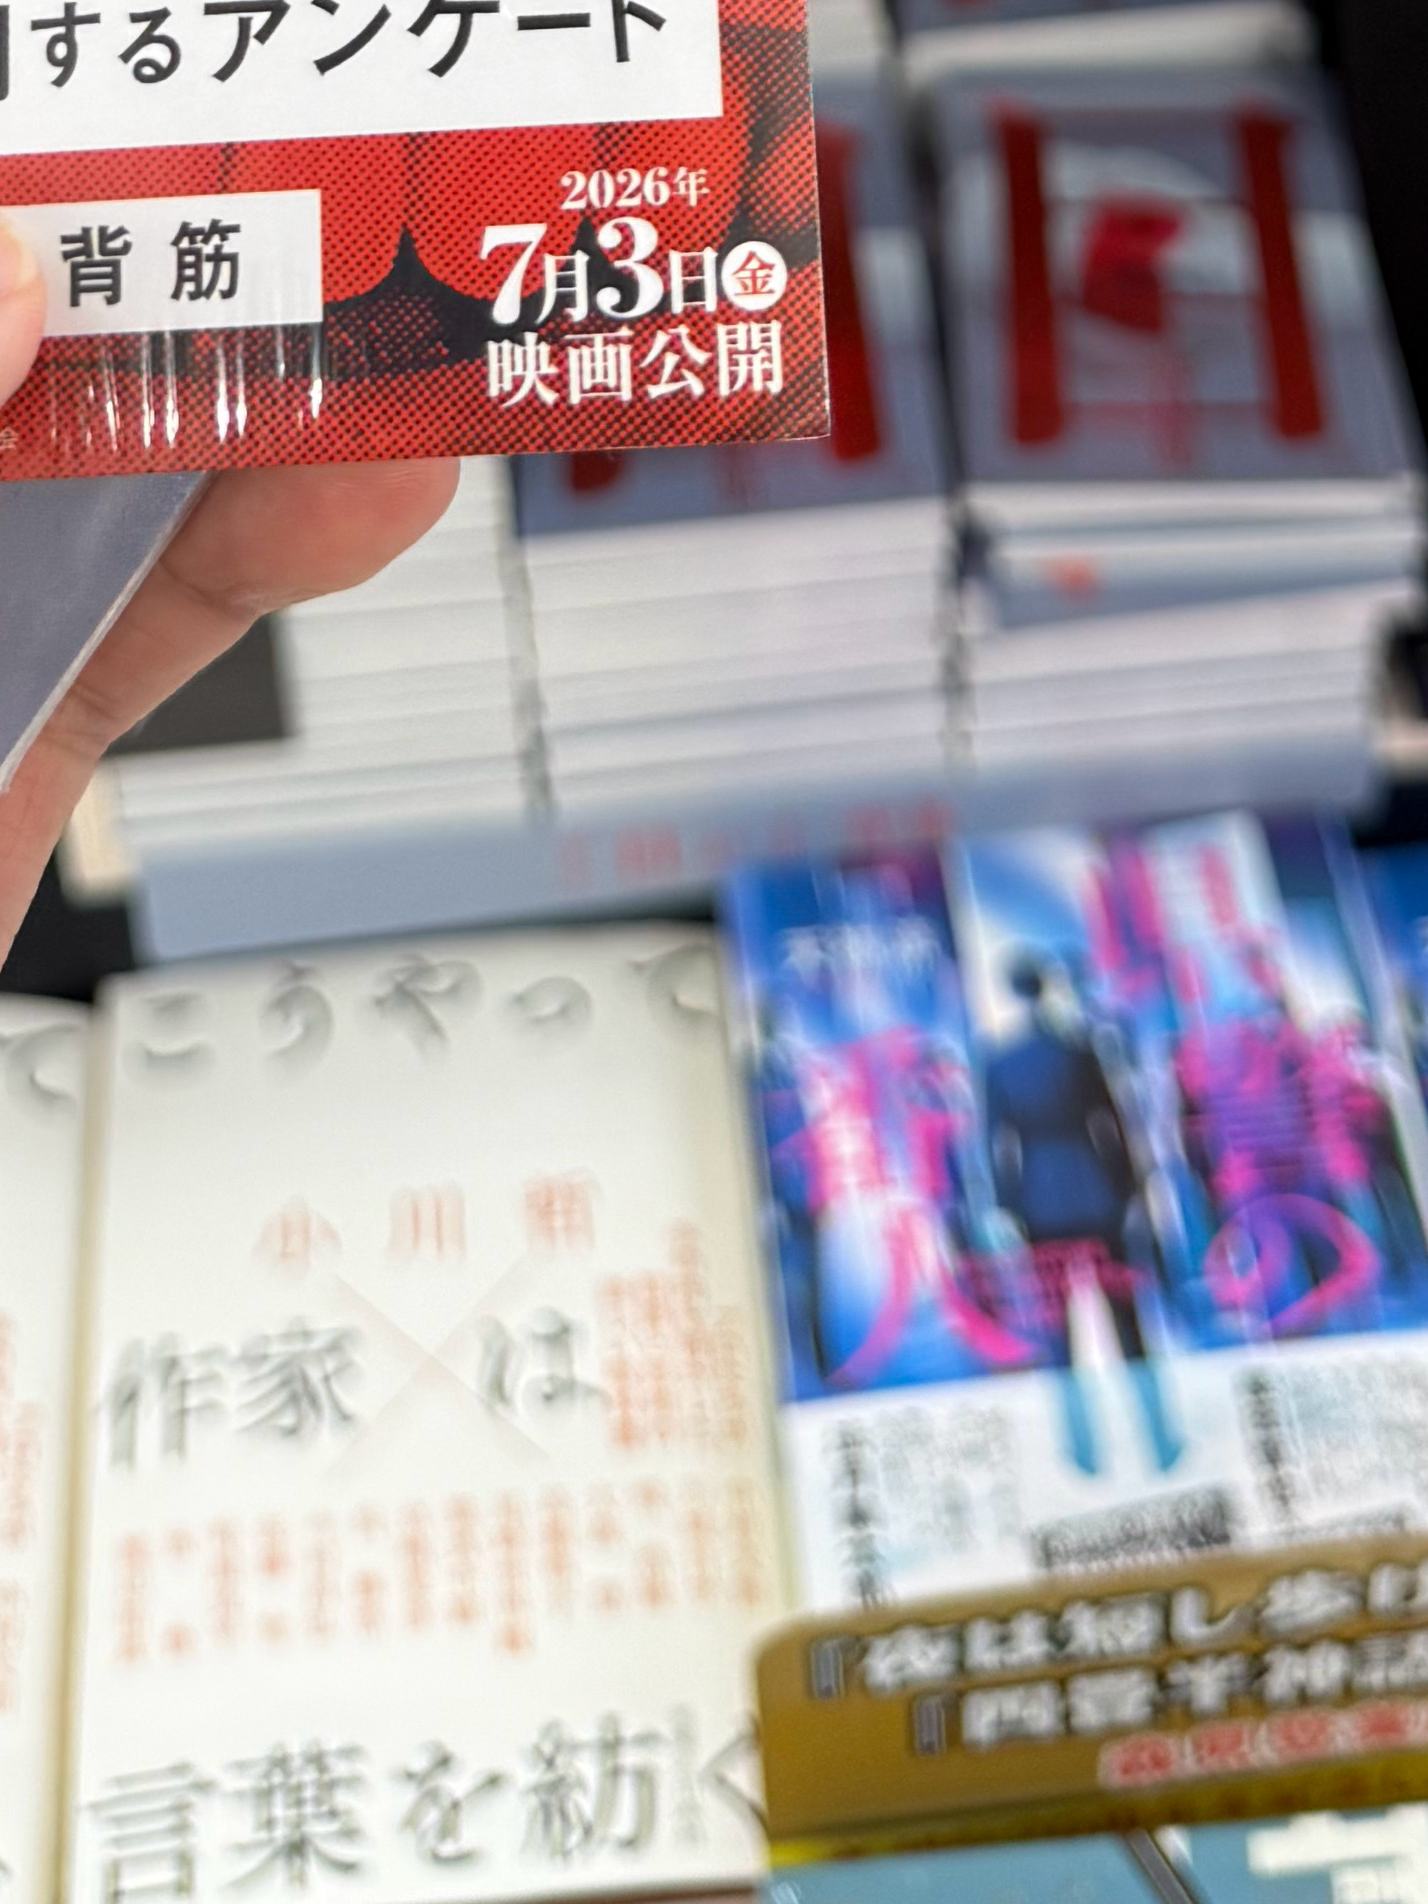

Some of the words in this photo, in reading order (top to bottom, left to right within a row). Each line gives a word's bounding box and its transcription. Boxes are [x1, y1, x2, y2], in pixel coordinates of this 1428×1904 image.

[559, 165, 712, 211] 2026年
[58, 218, 243, 309] 背筋
[486, 318, 786, 410] 映画公開
